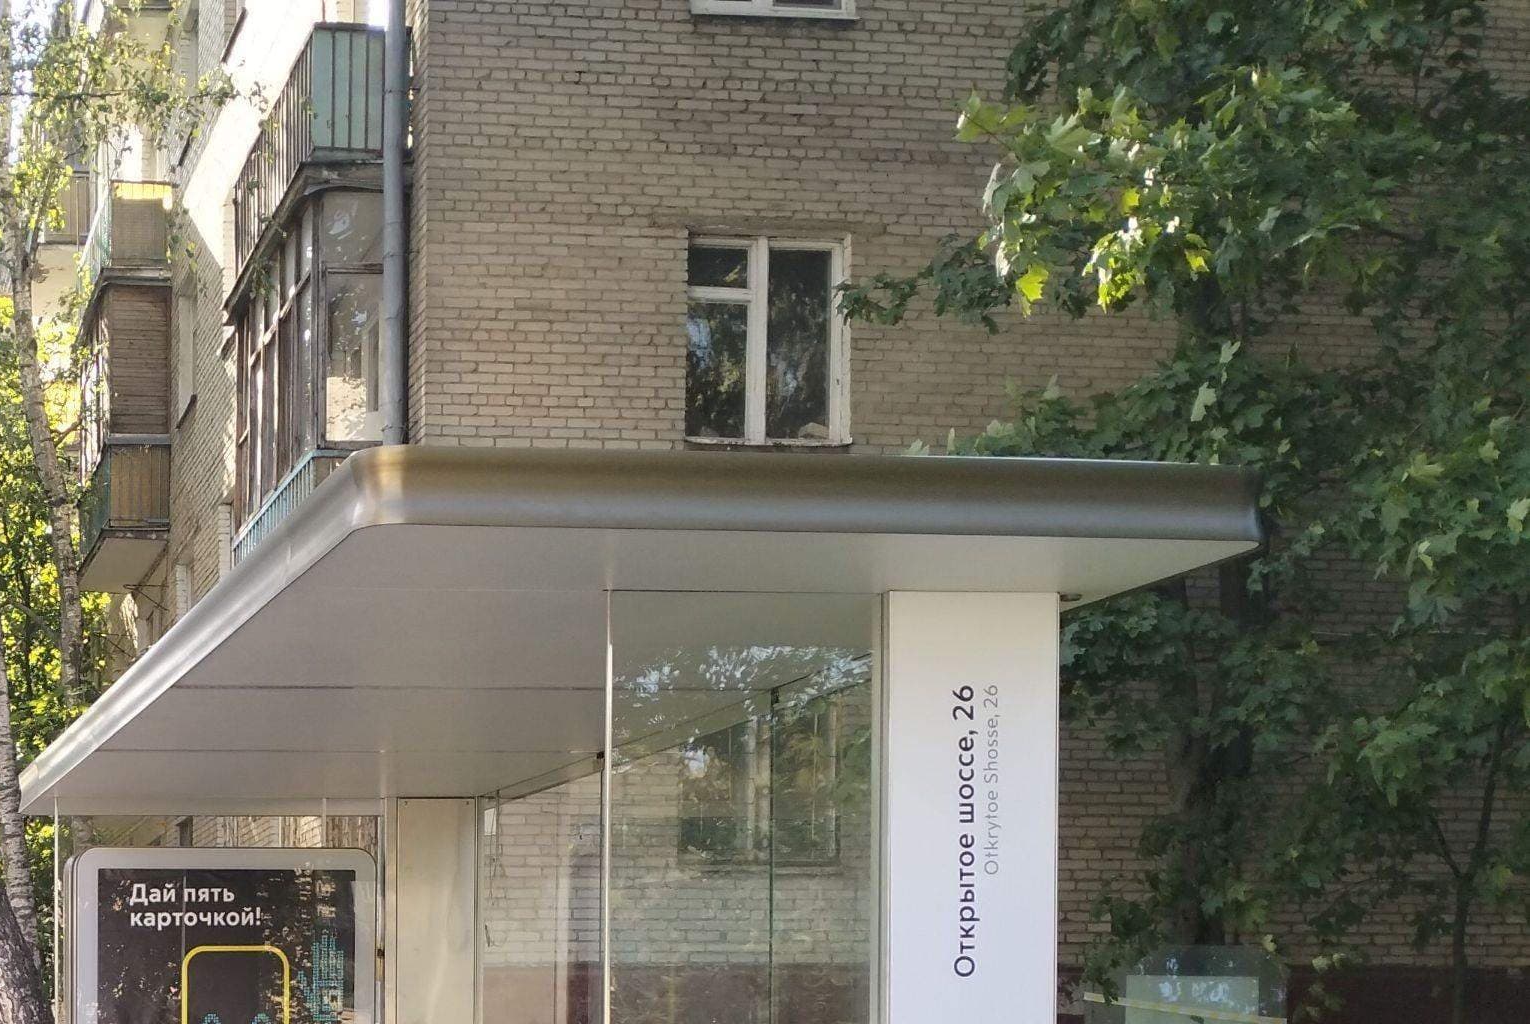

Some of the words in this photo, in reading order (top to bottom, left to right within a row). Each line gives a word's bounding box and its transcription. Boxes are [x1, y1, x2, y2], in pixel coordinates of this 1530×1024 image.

[952, 685, 974, 721] 26
[983, 685, 998, 708] 26
[983, 714, 1001, 784] Shosse,
[958, 729, 979, 823] шоссе,
[983, 790, 1002, 875] Otkrytoe
[129, 883, 176, 906] Дай
[184, 888, 235, 903] пять
[130, 906, 262, 931] карточкой!
[953, 833, 981, 978] Открытое
